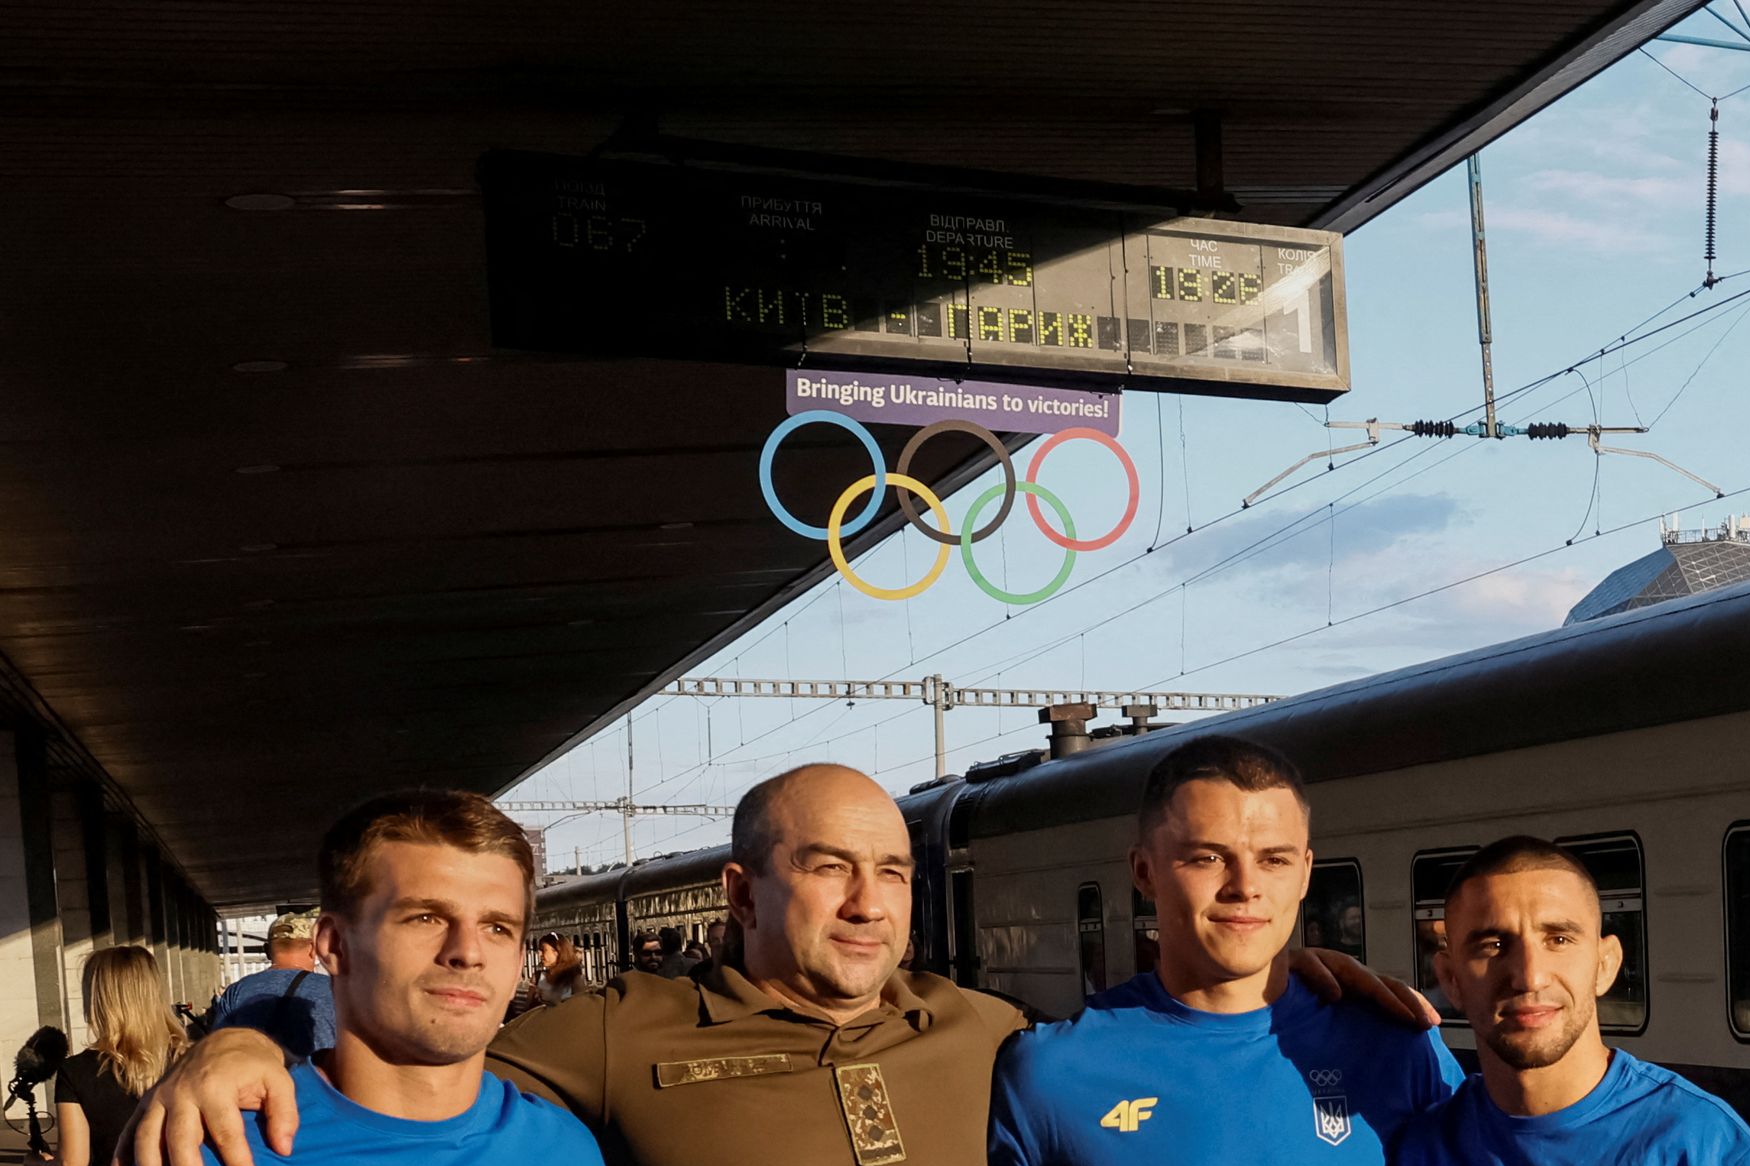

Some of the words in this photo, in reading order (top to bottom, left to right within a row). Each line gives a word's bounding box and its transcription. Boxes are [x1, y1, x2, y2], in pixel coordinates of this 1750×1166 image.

[556, 195, 607, 213] TRAIN
[741, 195, 823, 216] ПРИБУТТЯ
[551, 211, 647, 253] 067
[749, 213, 816, 232] ARRIVAL
[929, 213, 1011, 234] ВІДПРАВЛ.
[926, 229, 1014, 249] DEPARTURE
[1190, 238, 1218, 252] ЧАС
[917, 243, 1033, 287] 19:45
[1188, 253, 1223, 269] TIME
[947, 303, 1094, 349] ПАРИЖ
[796, 377, 886, 407] Bringing
[889, 384, 998, 411] Ukrainians
[1002, 395, 1024, 413] to
[1027, 395, 1110, 418] victories!
[1099, 1096, 1159, 1133] 4F
